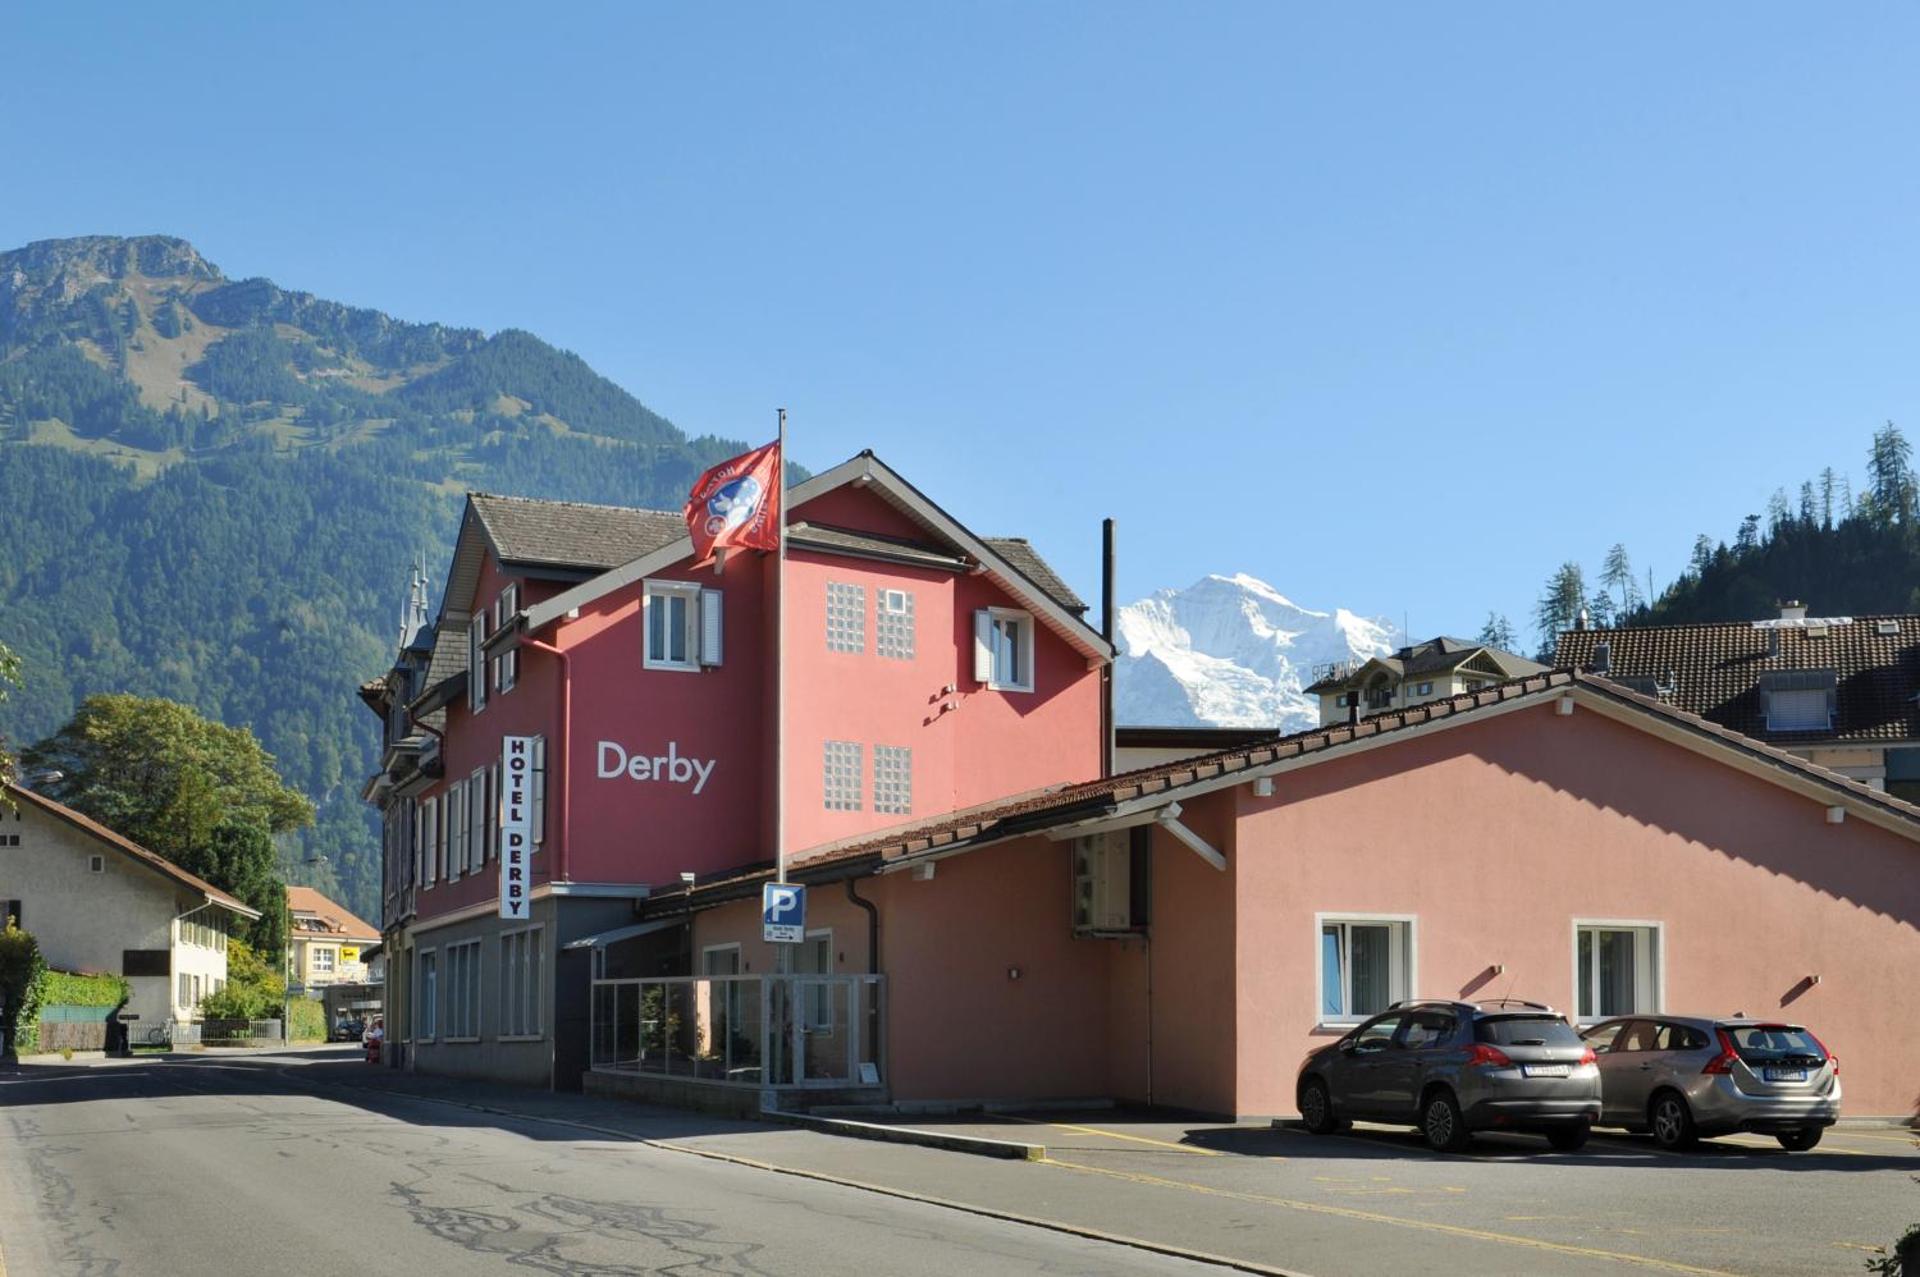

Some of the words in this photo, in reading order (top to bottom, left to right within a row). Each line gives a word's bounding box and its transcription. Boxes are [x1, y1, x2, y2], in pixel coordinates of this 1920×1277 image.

[510, 740, 525, 822] HOTEL
[597, 741, 716, 794] Derby
[509, 833, 523, 915] DERBY
[772, 889, 797, 922] P
